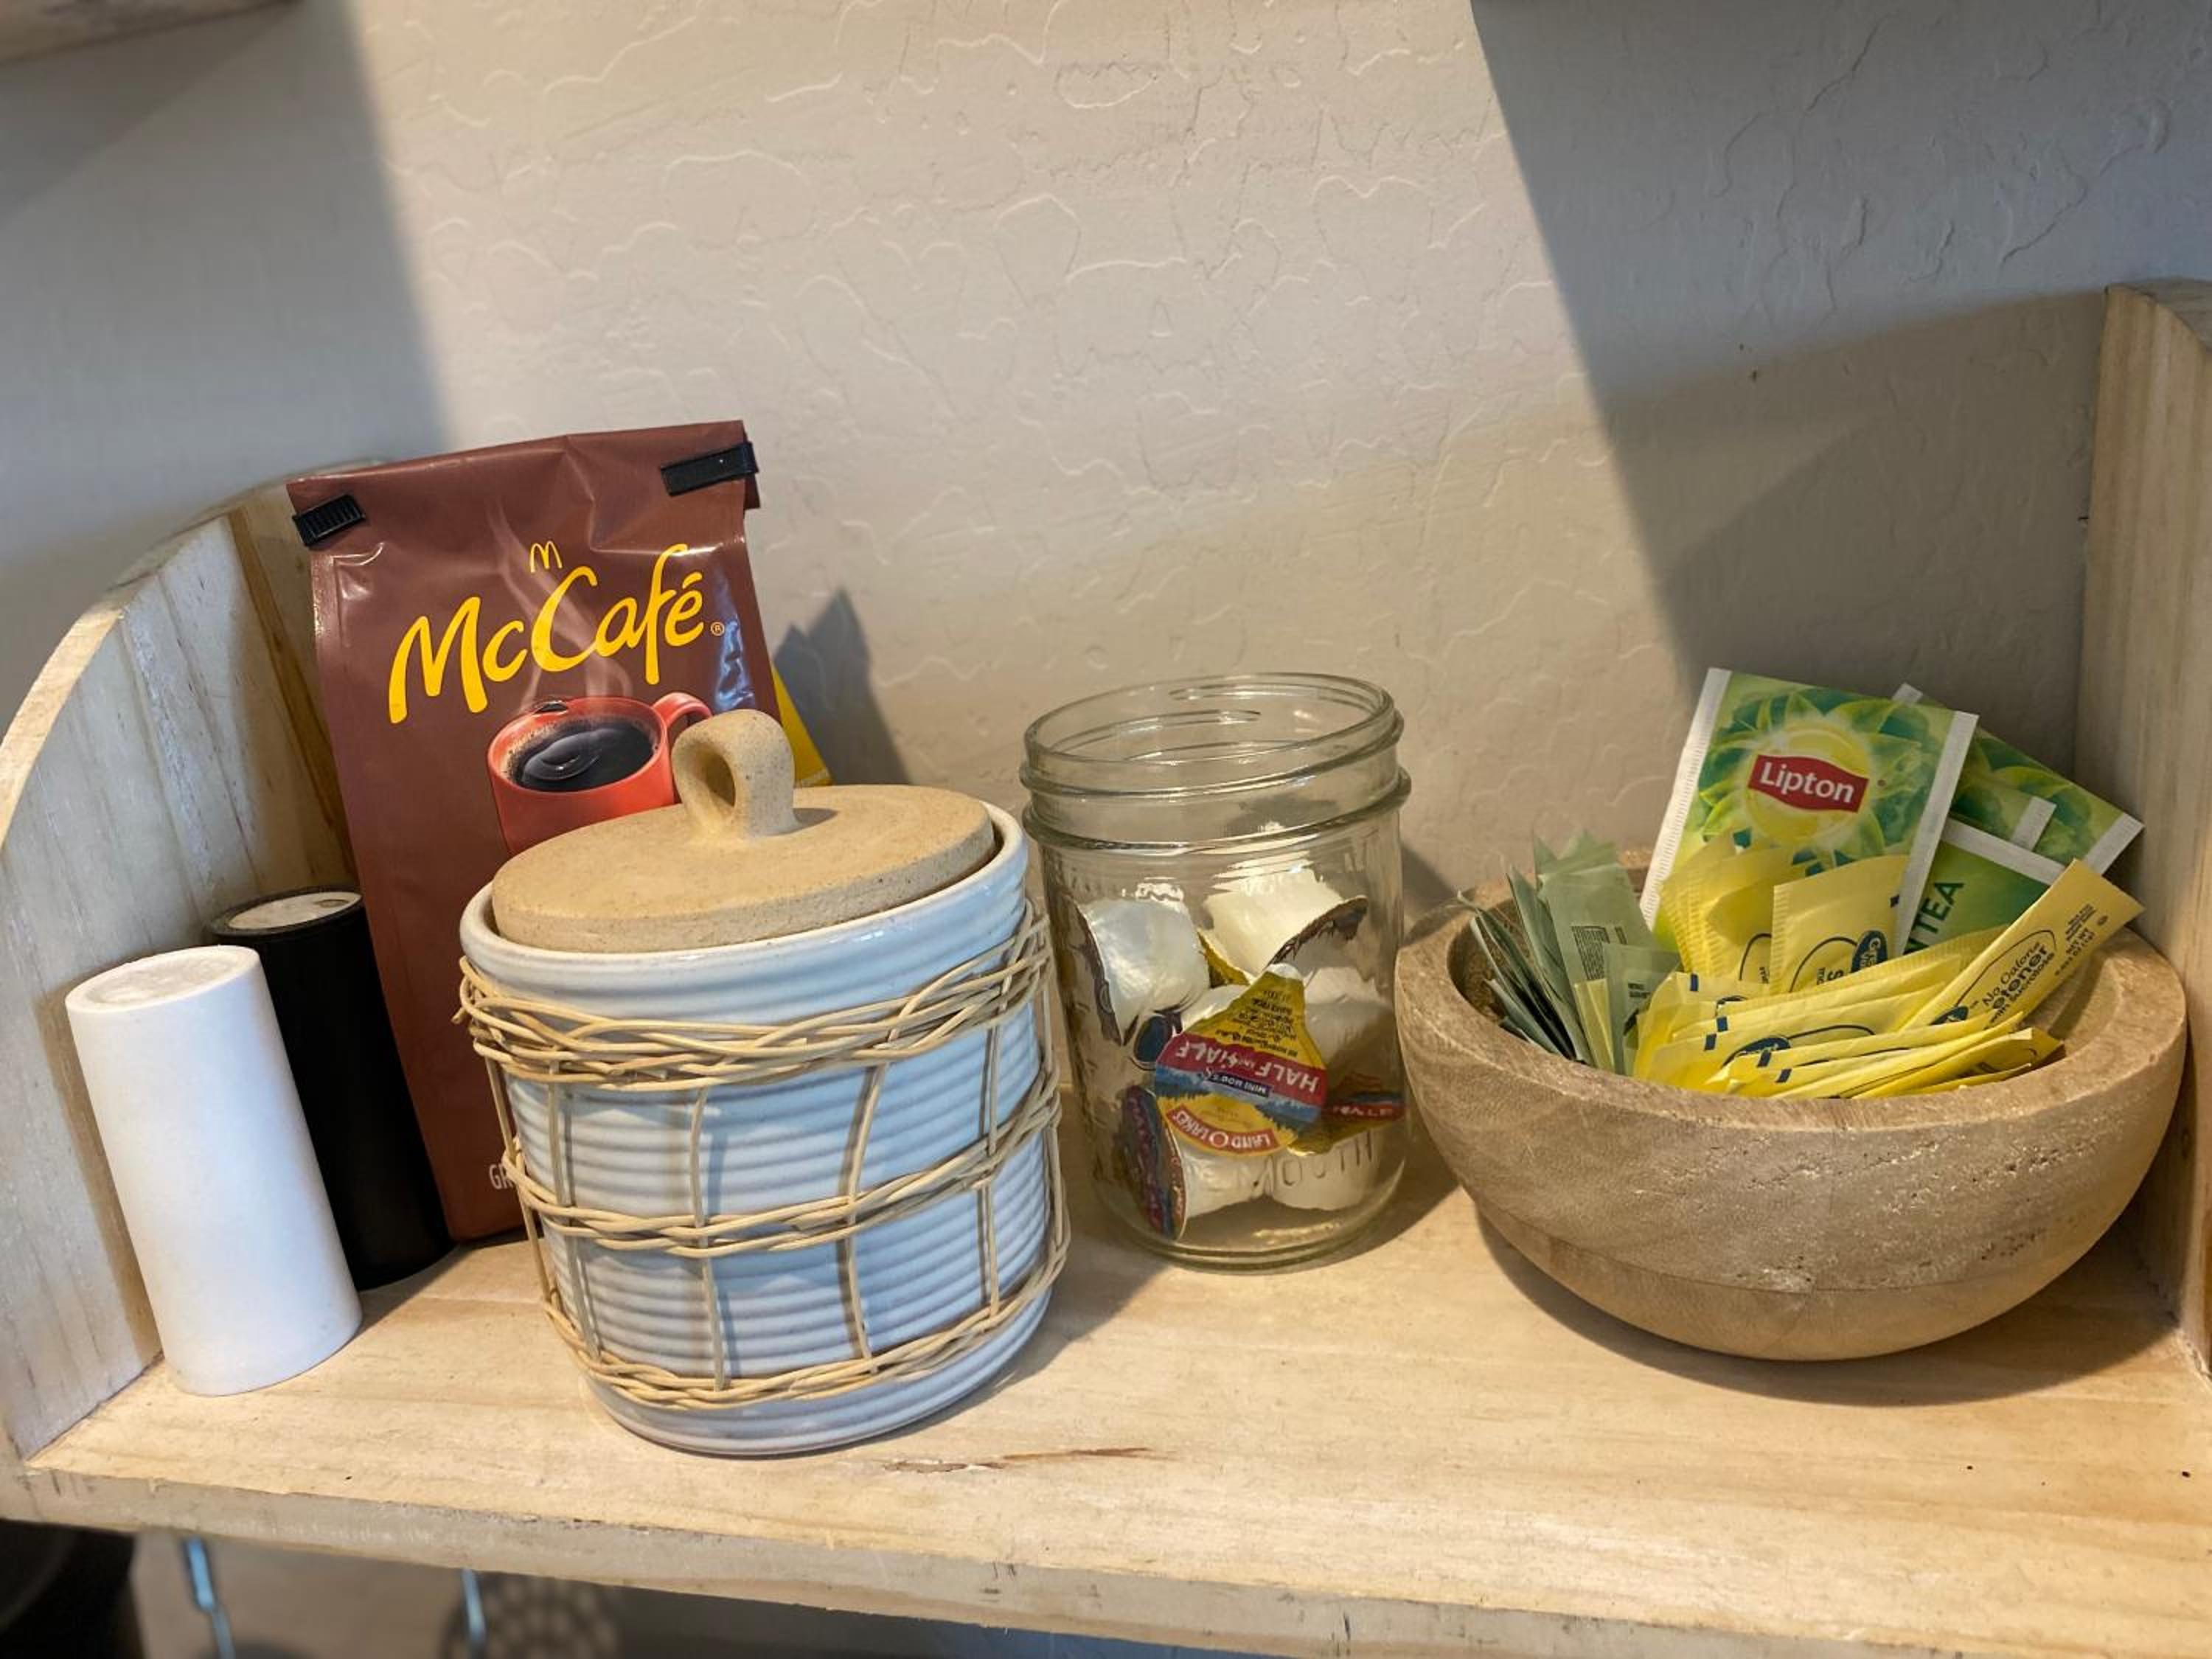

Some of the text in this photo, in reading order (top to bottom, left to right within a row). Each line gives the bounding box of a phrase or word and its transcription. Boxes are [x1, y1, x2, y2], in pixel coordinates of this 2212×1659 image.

[389, 543, 705, 724] McCafé
[1759, 762, 1855, 803] Lipton
[1911, 883, 1966, 934] TEA
[1982, 987, 2000, 1006] No
[1255, 1061, 1321, 1093] HALF
[1208, 1130, 1229, 1149] O
[1231, 1133, 1271, 1150] LAND
